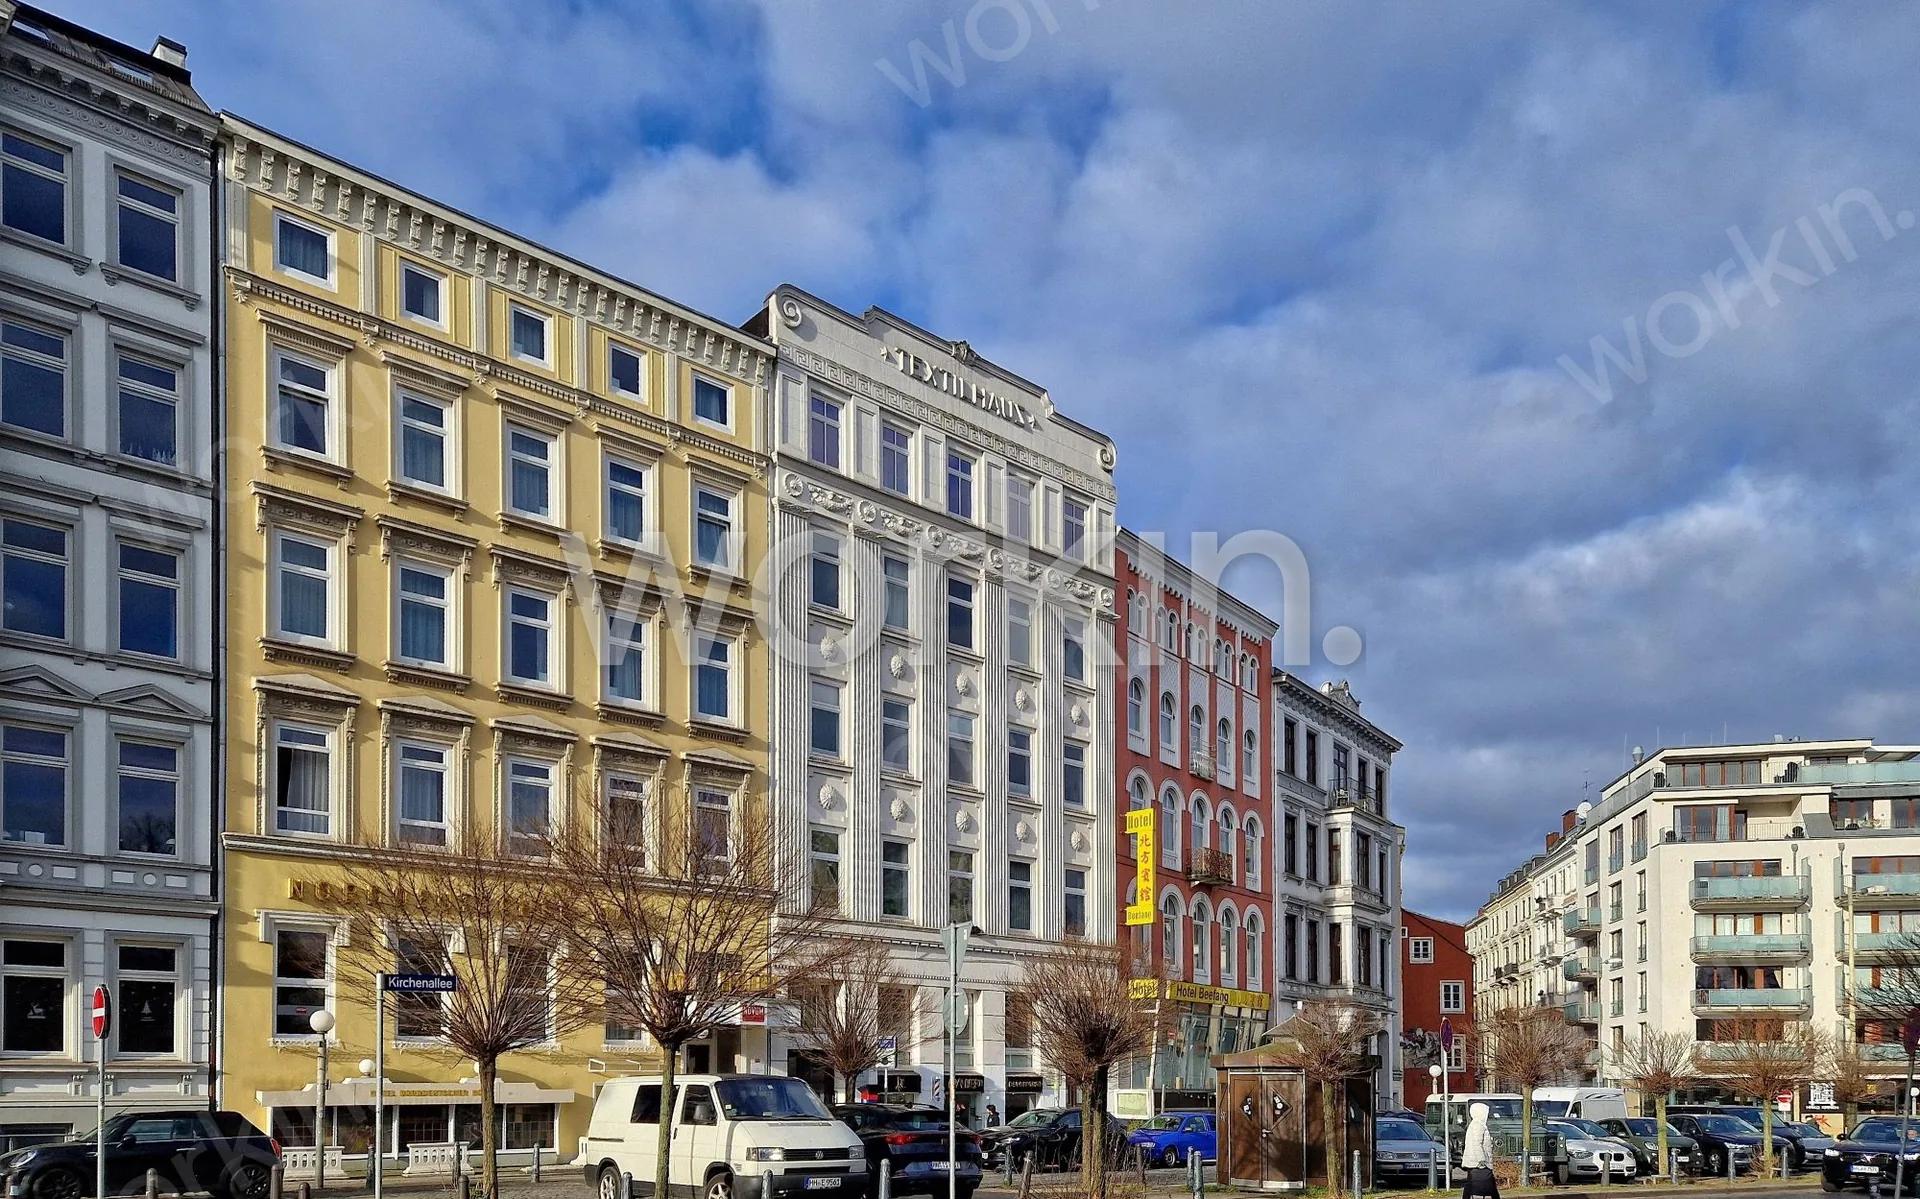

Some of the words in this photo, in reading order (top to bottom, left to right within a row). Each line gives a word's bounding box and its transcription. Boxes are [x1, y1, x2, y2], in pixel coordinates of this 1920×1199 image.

[1128, 812, 1152, 829] Hotel
[388, 976, 453, 989] Kirchenallee
[1132, 981, 1155, 995] Hotel
[1177, 983, 1196, 999] Hotel
[1199, 986, 1229, 1005] Beefang
